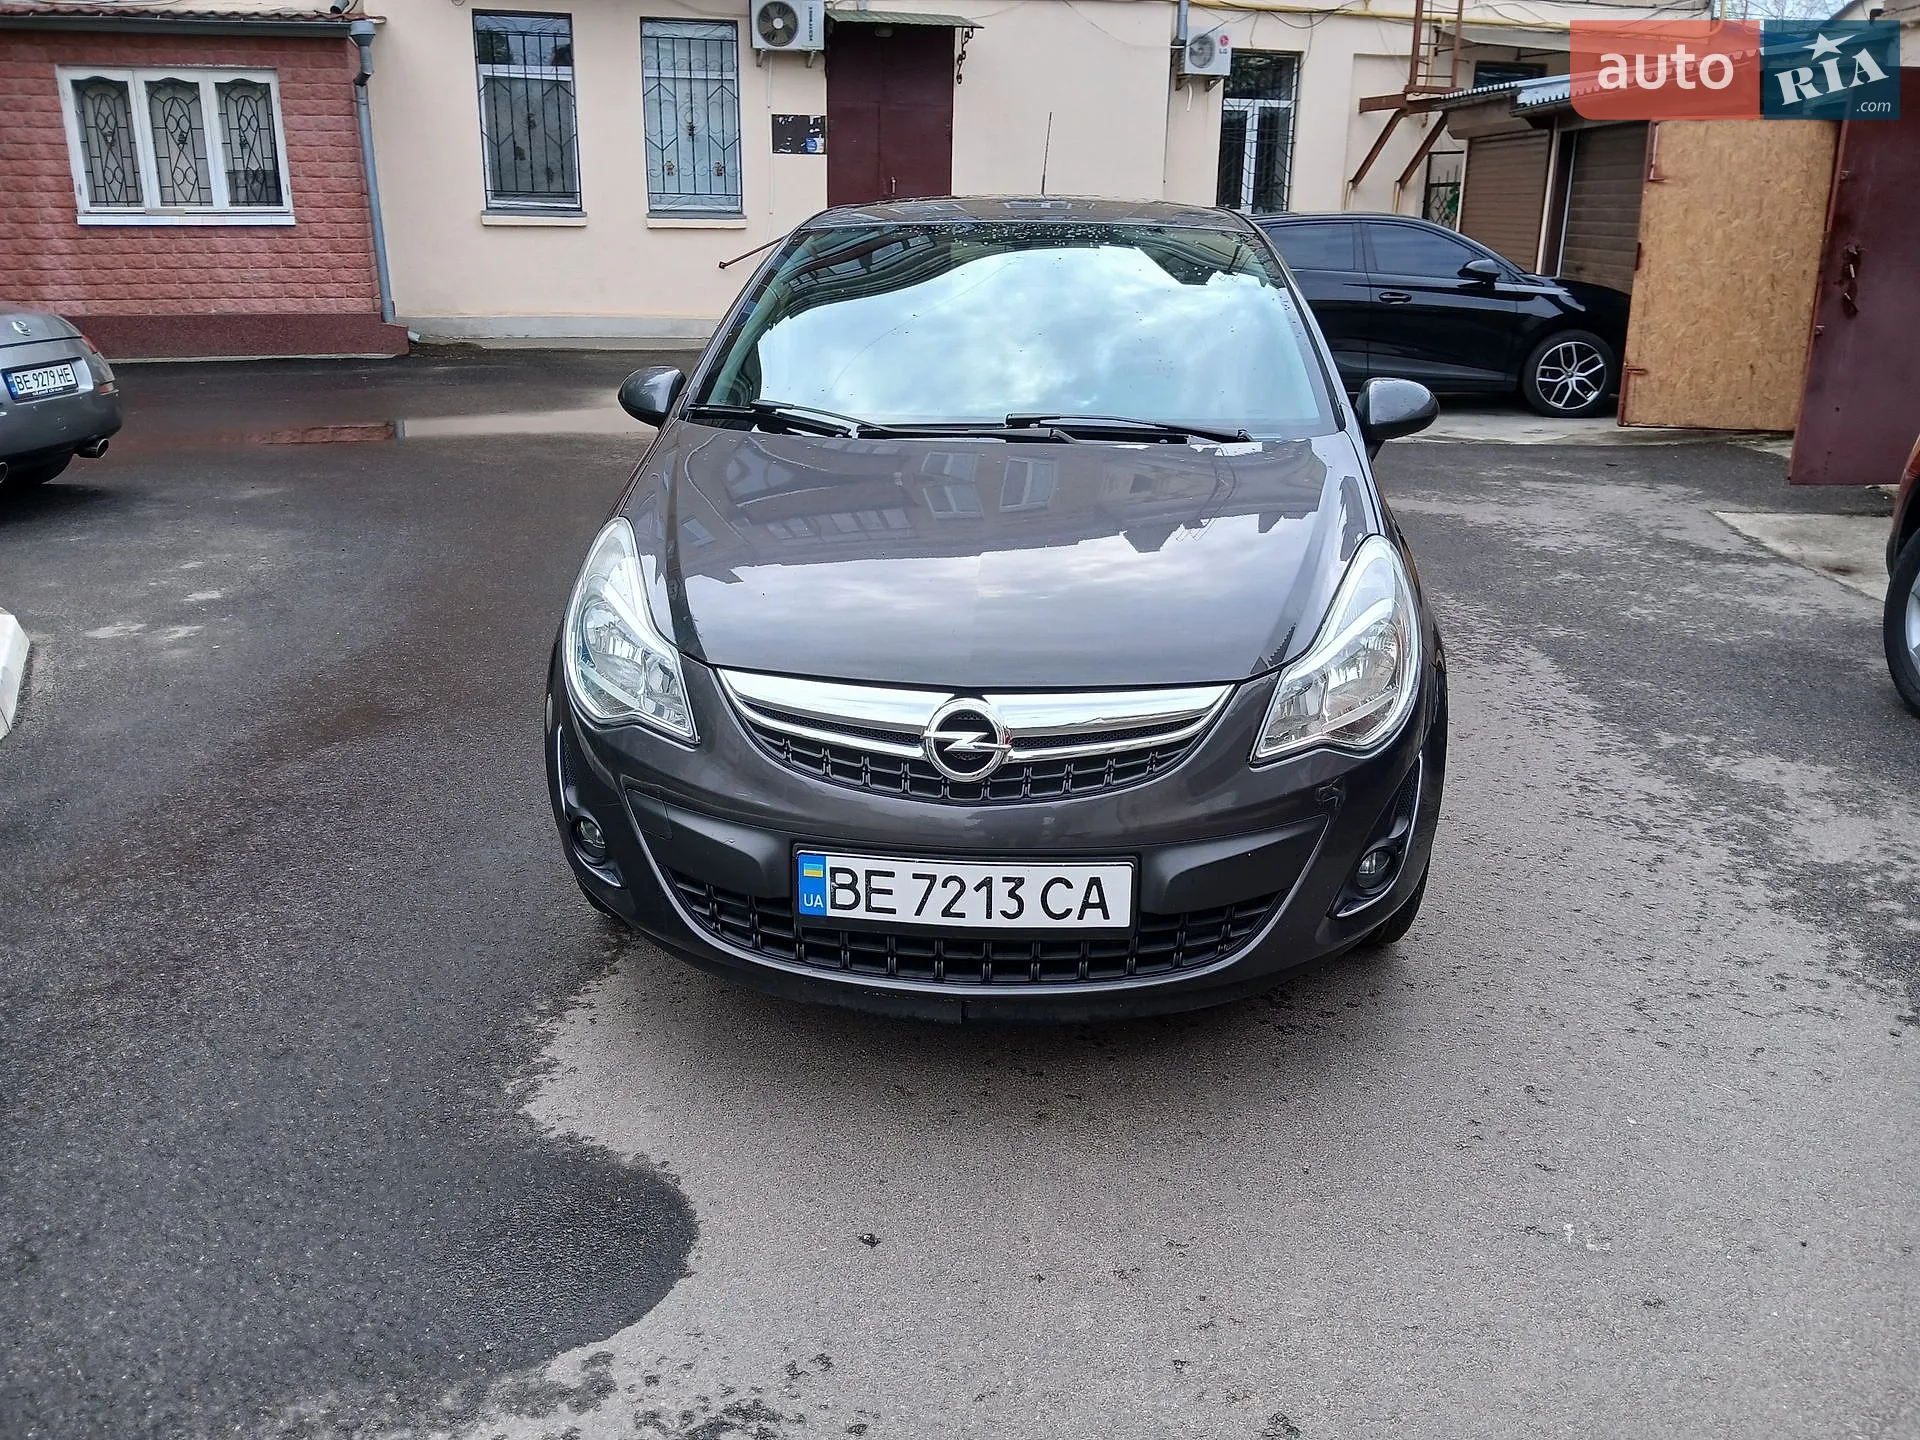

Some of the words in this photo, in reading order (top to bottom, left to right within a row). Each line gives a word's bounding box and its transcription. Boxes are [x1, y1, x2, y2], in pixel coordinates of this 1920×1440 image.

[14, 374, 33, 391] BE
[32, 370, 56, 388] 9279
[57, 367, 73, 384] HE
[803, 894, 824, 908] UA
[829, 866, 897, 915] BE
[911, 872, 1026, 920] 7213
[1040, 876, 1111, 920] CA
